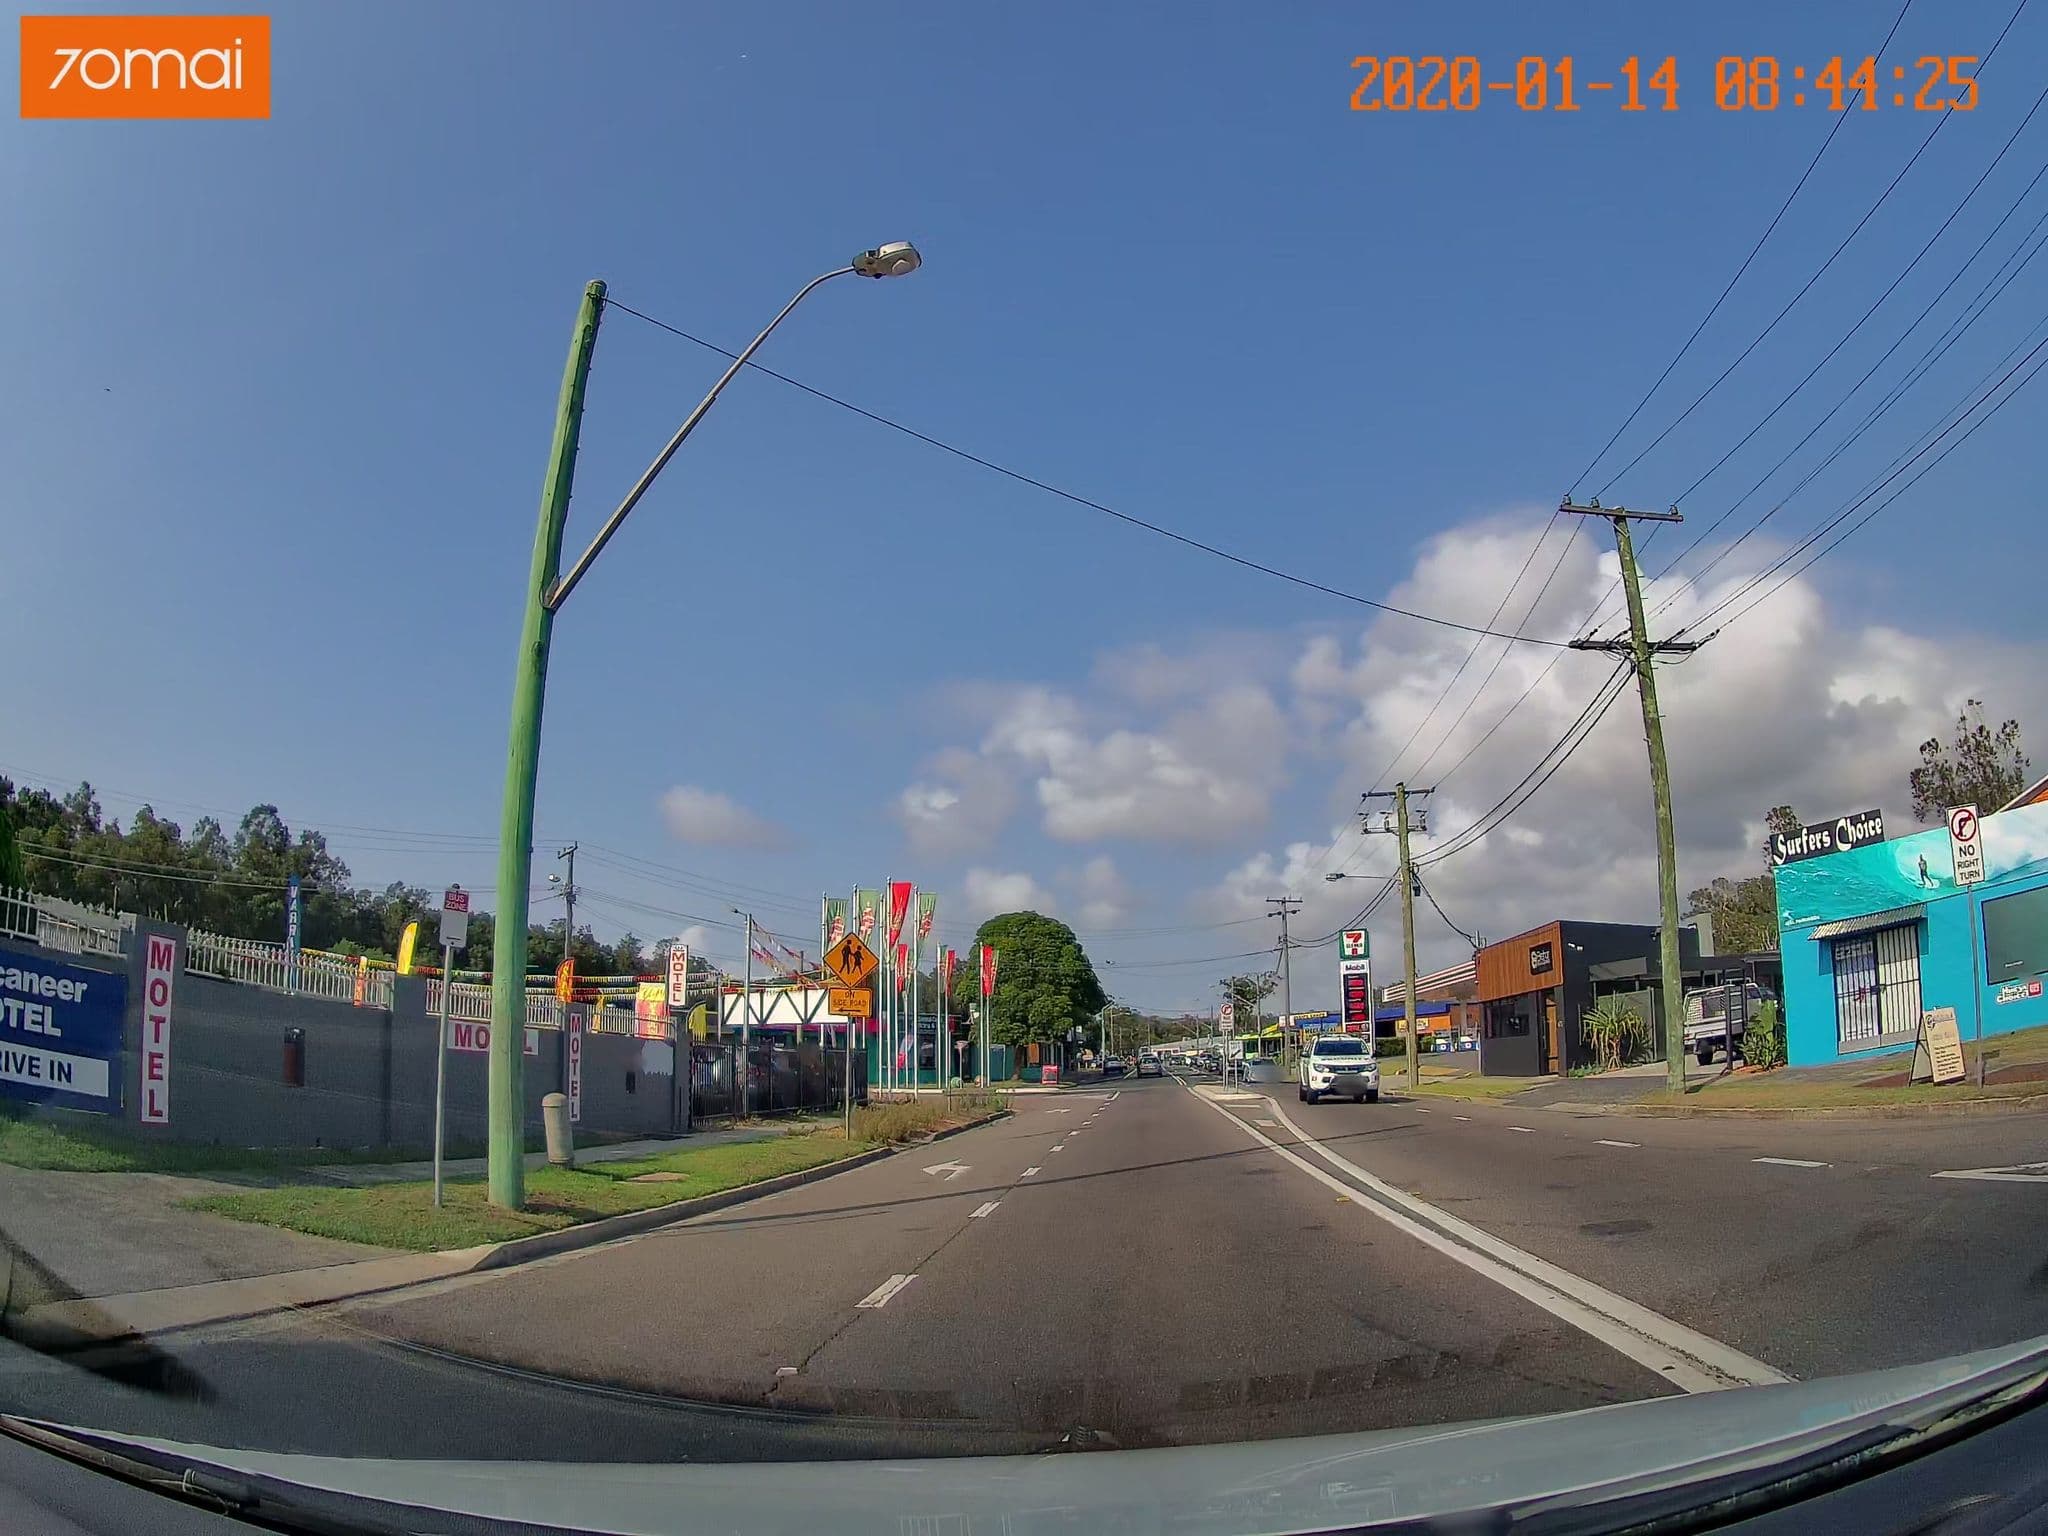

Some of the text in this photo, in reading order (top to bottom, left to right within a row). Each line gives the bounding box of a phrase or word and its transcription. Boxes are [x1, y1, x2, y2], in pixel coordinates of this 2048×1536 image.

[1773, 813, 1882, 865] Surfers Choice
[1959, 844, 1975, 857] NO
[1957, 857, 1979, 870] RIGHT
[1959, 869, 1980, 881] TURN
[445, 900, 467, 911] ZONE
[448, 893, 465, 903] BUS
[672, 952, 686, 1003] MOTEL
[0, 997, 62, 1037] TEL
[148, 940, 173, 1118] MOTEL
[454, 1023, 534, 1053] MOL
[0, 1050, 72, 1083] IVE IN
[570, 1015, 581, 1119] MOTEL
